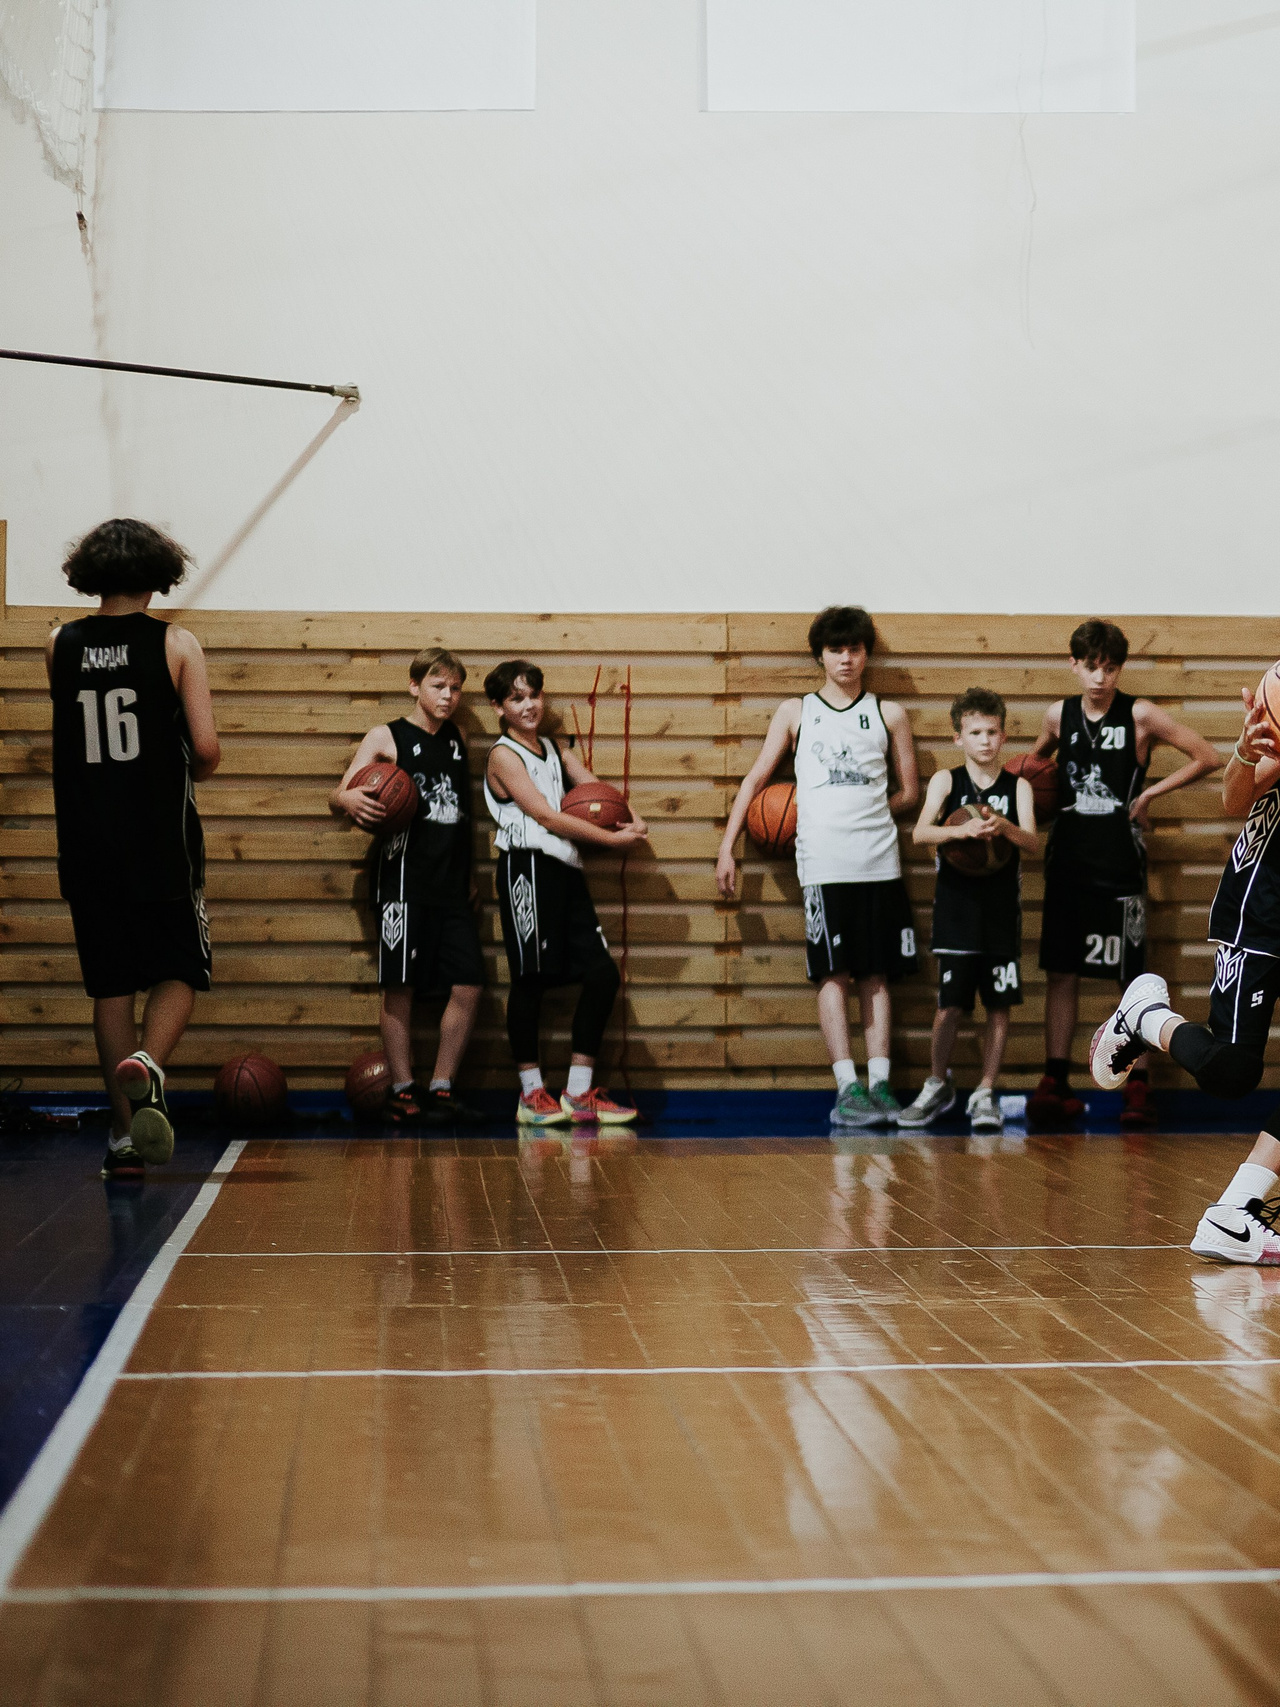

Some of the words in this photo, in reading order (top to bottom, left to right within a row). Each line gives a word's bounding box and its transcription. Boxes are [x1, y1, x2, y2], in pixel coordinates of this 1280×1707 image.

[76, 687, 140, 763] 16
[859, 713, 870, 729] 8
[1101, 726, 1126, 750] 20
[901, 928, 916, 957] 8
[1085, 934, 1121, 965] 20
[992, 962, 1018, 993] 34
